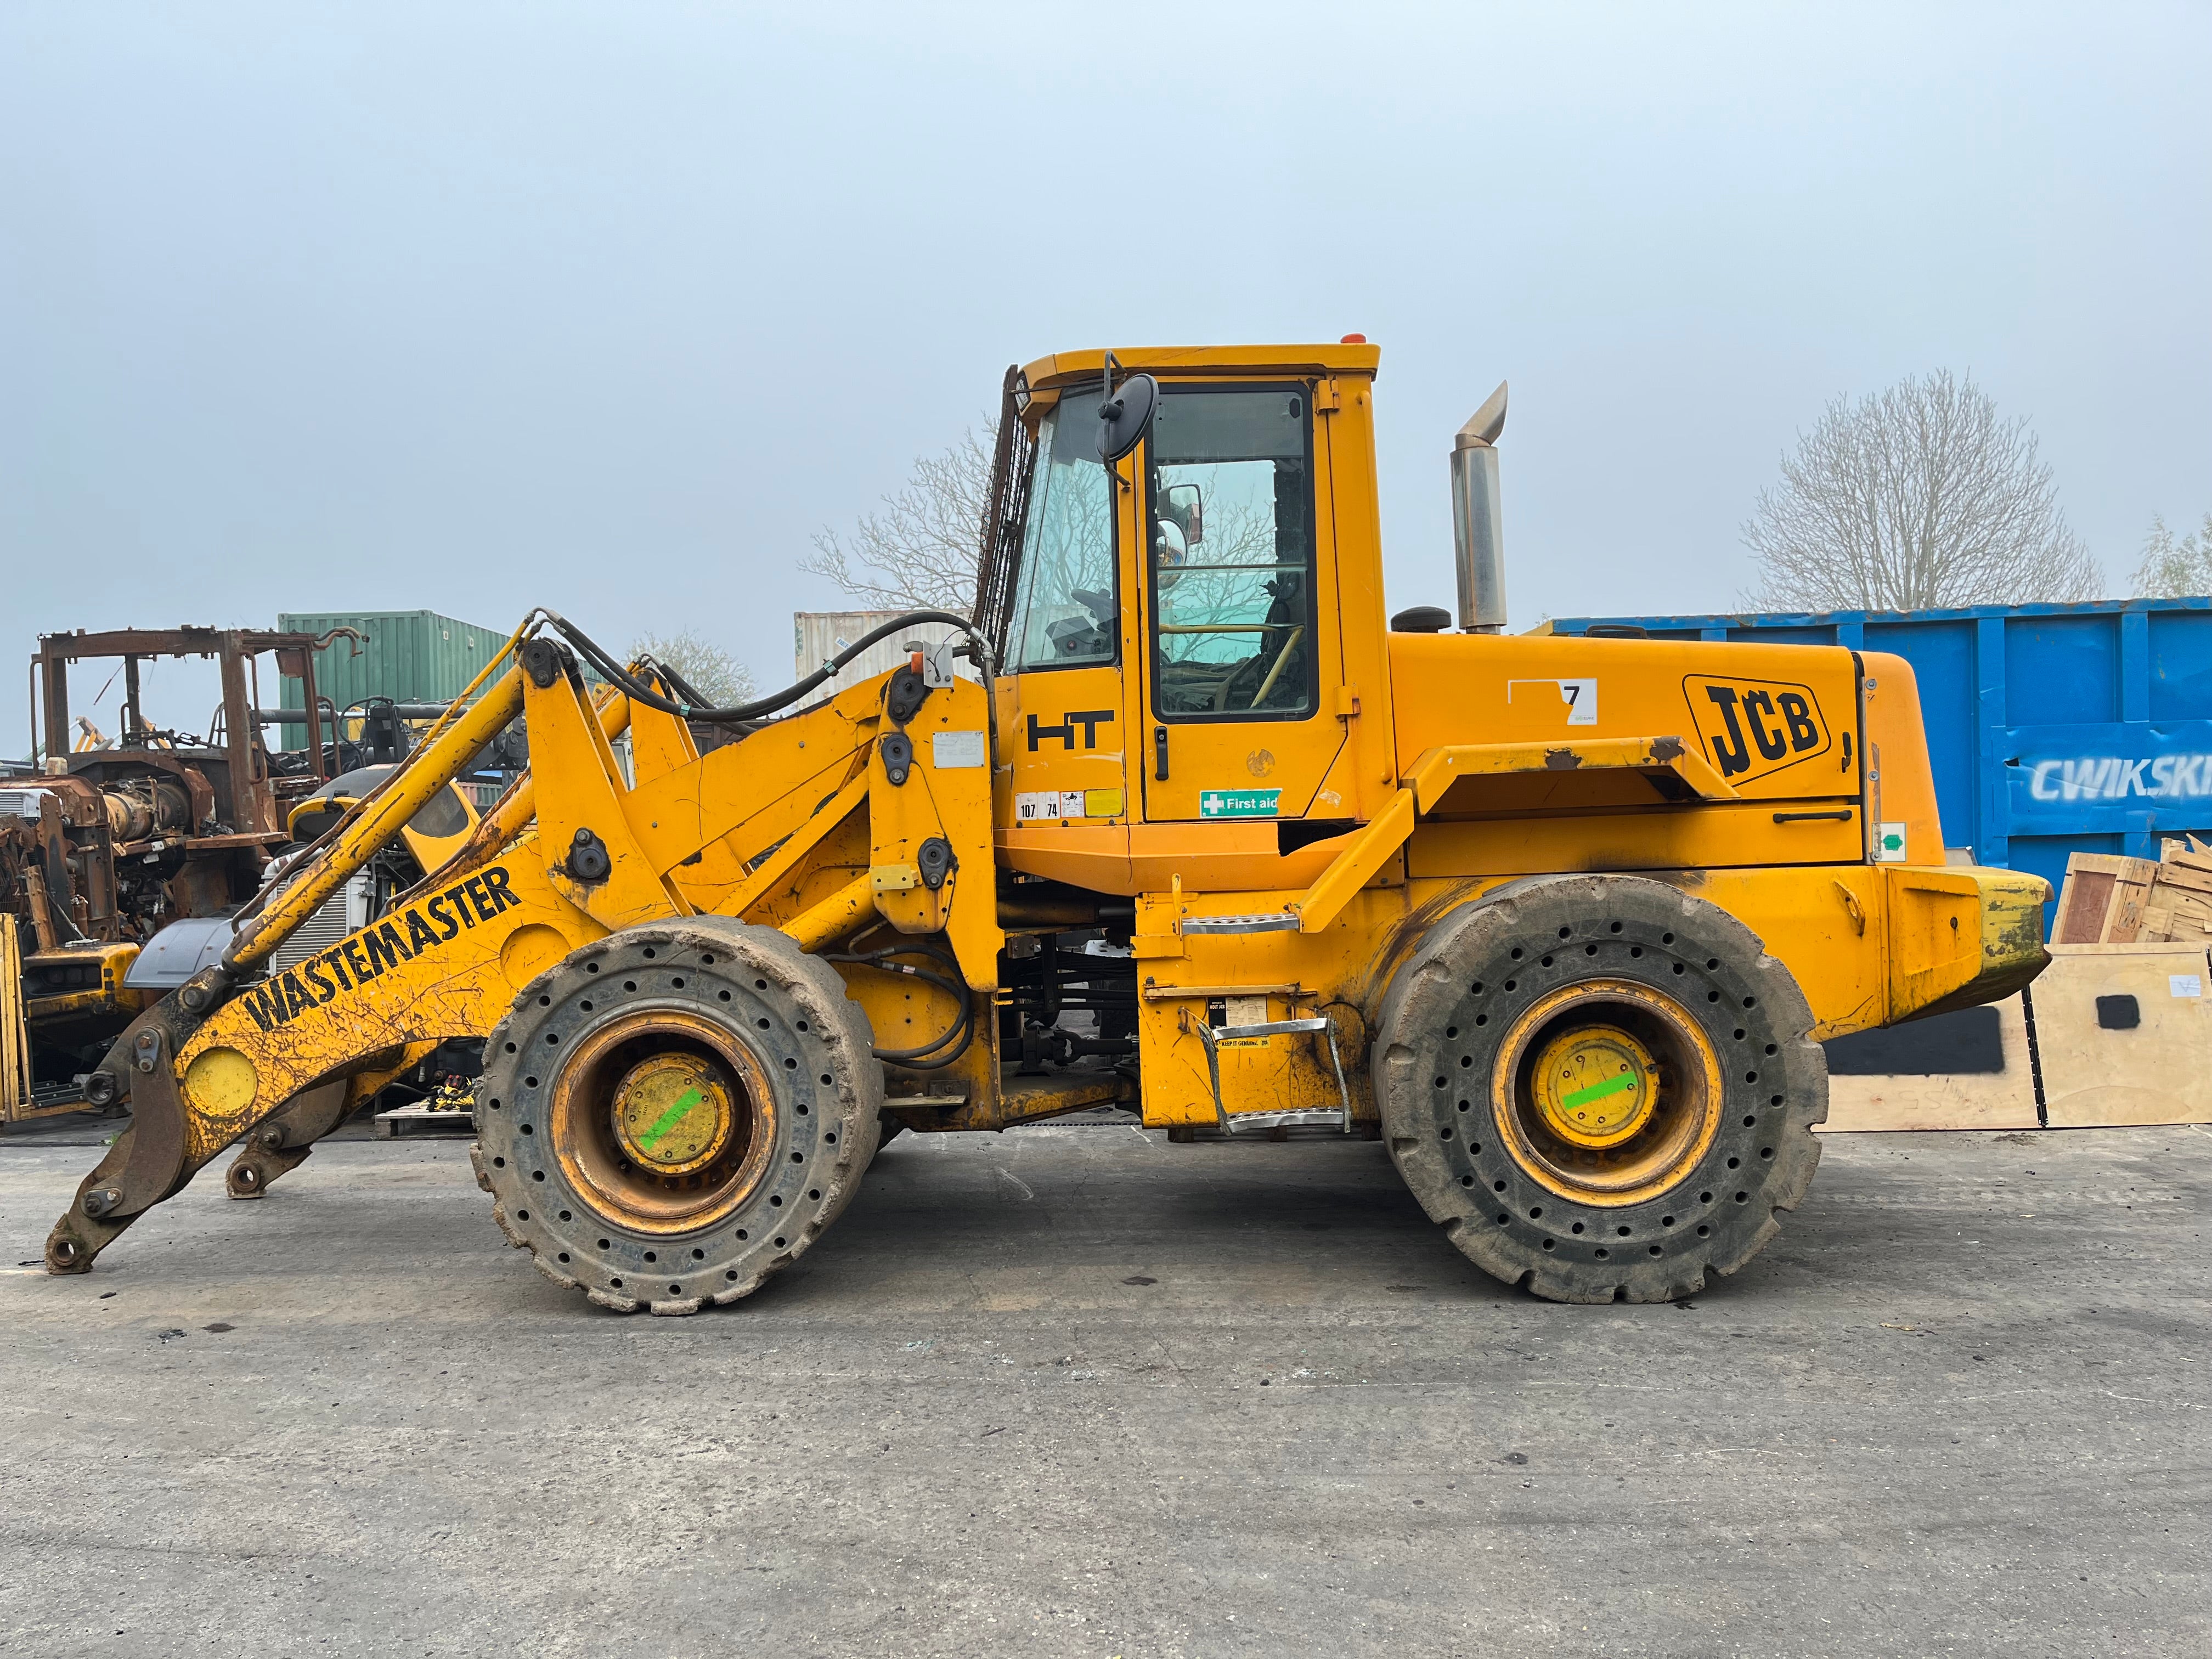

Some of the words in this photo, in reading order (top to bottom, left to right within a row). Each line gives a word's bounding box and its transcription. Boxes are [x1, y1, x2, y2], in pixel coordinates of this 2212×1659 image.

[1564, 686, 1579, 705] 7
[1027, 710, 1114, 751] HT
[1705, 686, 1819, 777] JCB
[2031, 756, 2212, 799] CWIKSKI
[1021, 804, 1035, 817] 107
[1047, 804, 1057, 816] 74
[1227, 798, 1256, 809] First
[1259, 797, 1278, 808] aid
[242, 866, 522, 1032] WASTEMASTER
